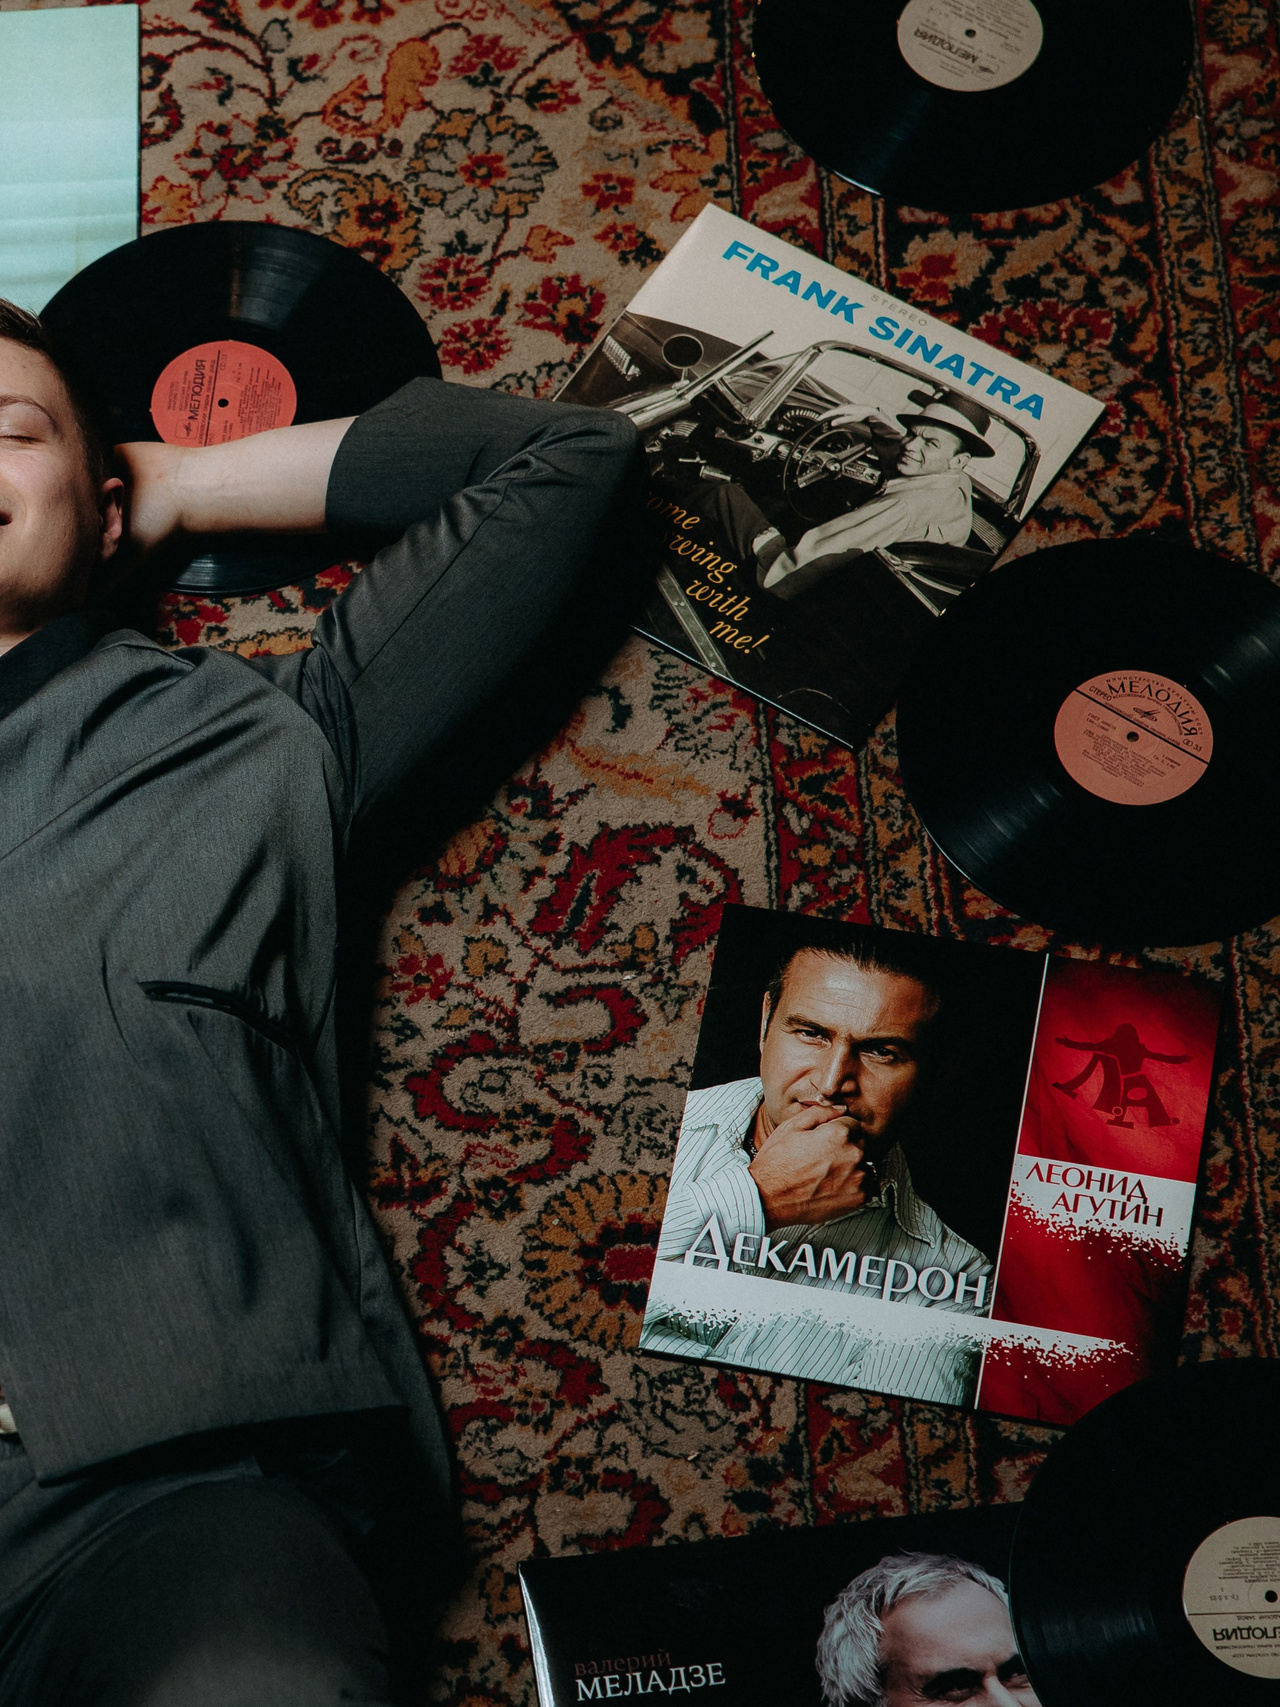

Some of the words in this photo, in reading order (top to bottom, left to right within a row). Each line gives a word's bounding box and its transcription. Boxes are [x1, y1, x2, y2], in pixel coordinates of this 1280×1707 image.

[871, 294, 928, 327] STEREO
[722, 240, 865, 325] FRANK
[868, 316, 1045, 421] SINATRA
[188, 359, 207, 421] МЕЛОДИЯ
[646, 495, 701, 530] ome
[686, 579, 751, 621] with
[709, 620, 770, 654] me!
[1088, 685, 1112, 701] СТЕРЕО
[1107, 680, 1198, 736] МЕЛОДИЯ
[1192, 743, 1203, 753] 33
[1025, 1161, 1149, 1205] ЛЕОНИД
[1051, 1191, 1164, 1228] АГУТИН
[1212, 1626, 1280, 1641] ЛОДИЯ
[574, 1648, 672, 1677] валерий
[575, 1662, 726, 1702] МЕЛАДЗЕ
